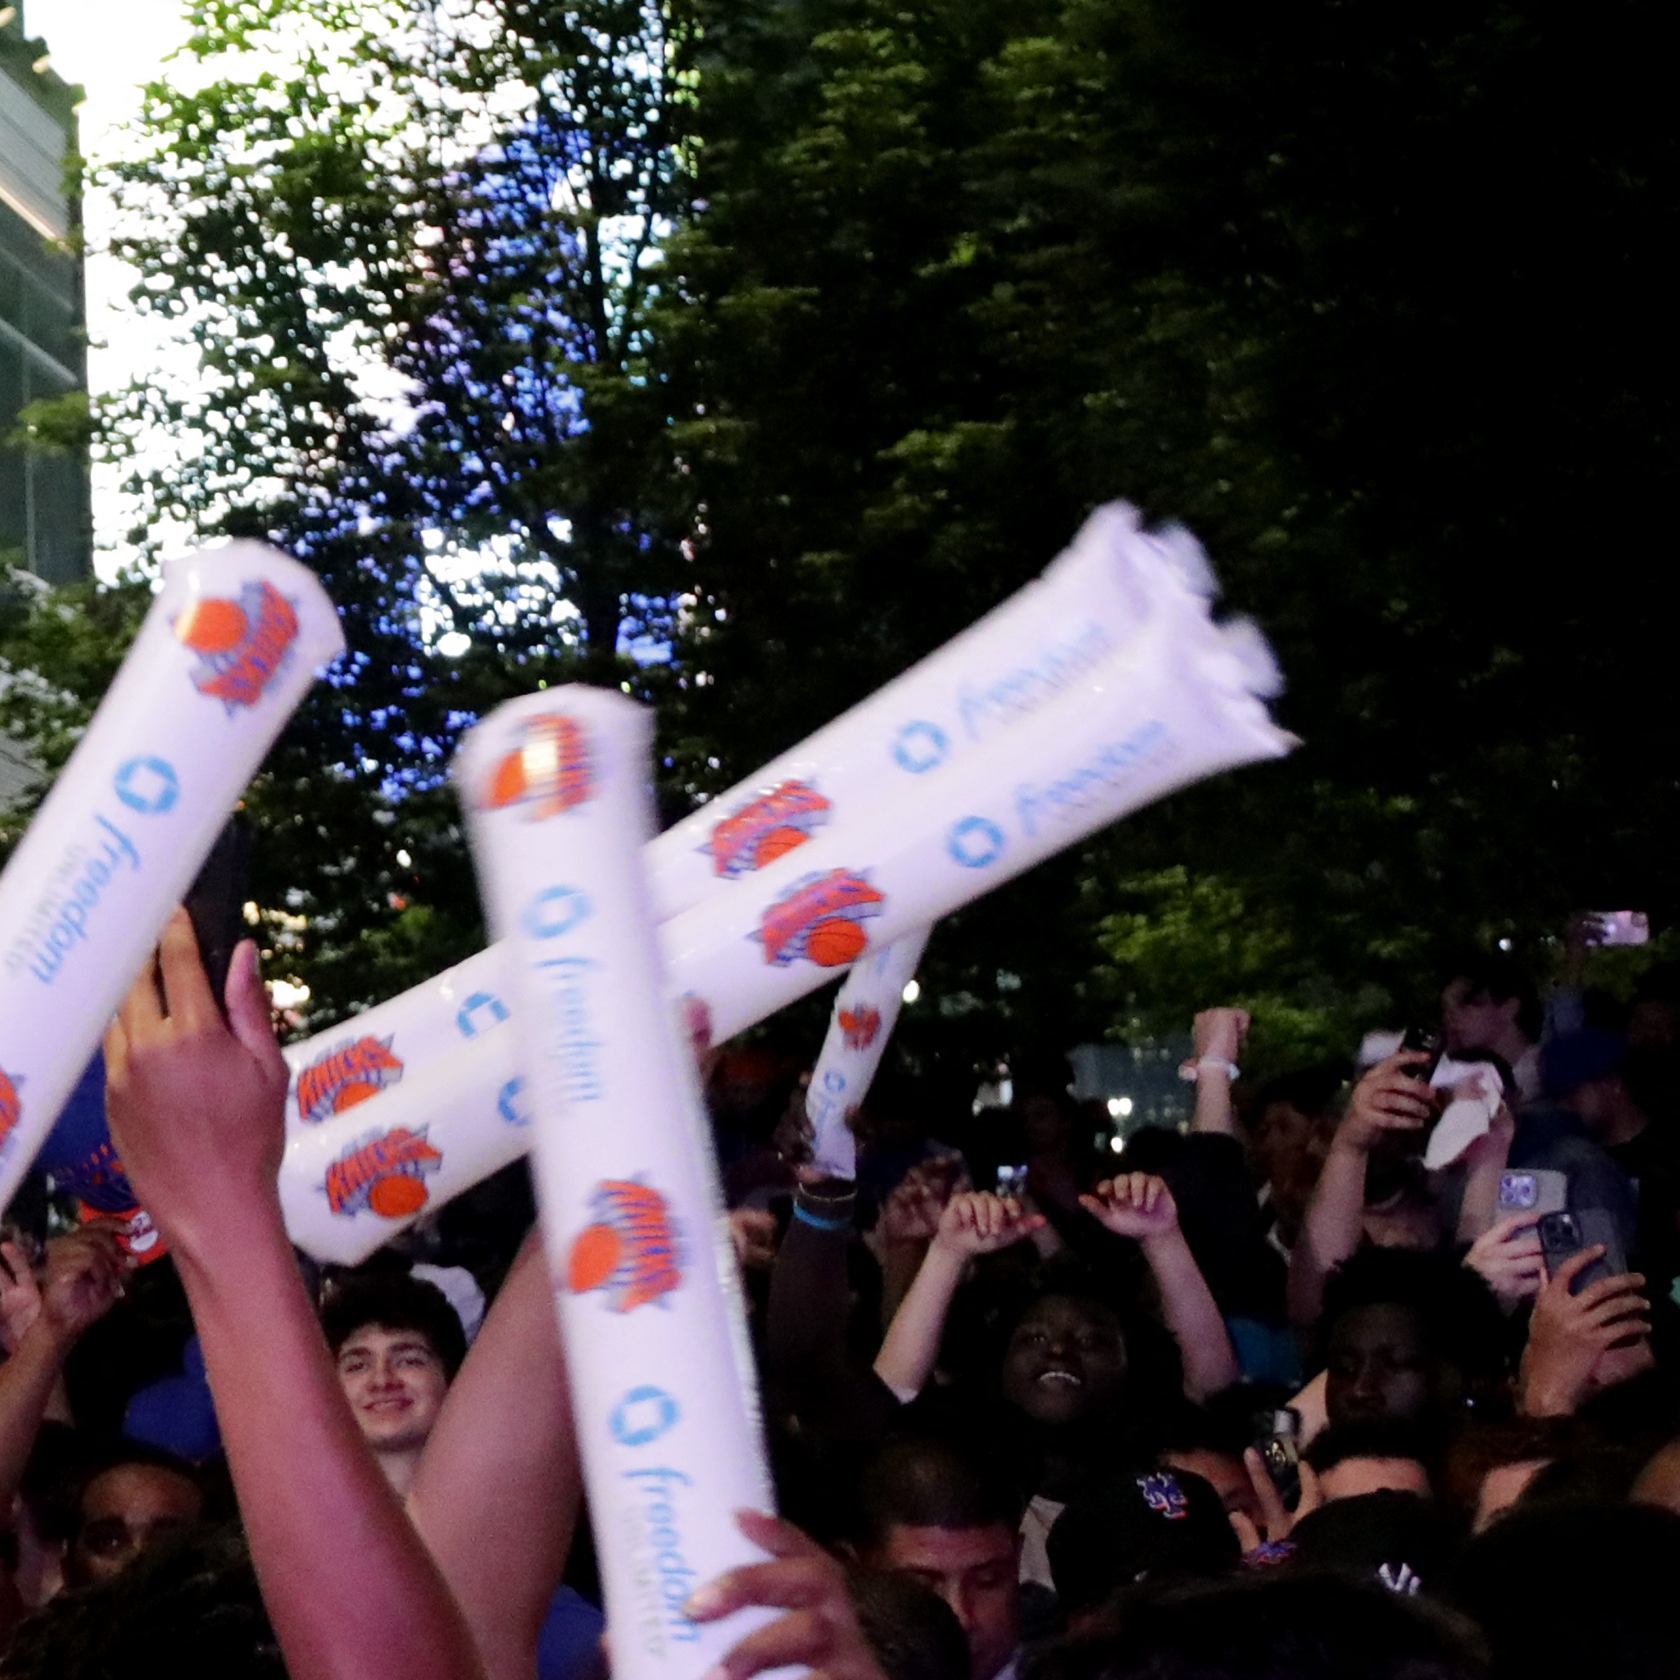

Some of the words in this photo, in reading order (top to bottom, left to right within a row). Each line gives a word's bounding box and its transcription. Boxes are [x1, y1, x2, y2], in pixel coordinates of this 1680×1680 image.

[31, 814, 141, 984] freedom
[297, 1034, 405, 1122] KNICKS
[326, 1126, 445, 1217] KNICKS
